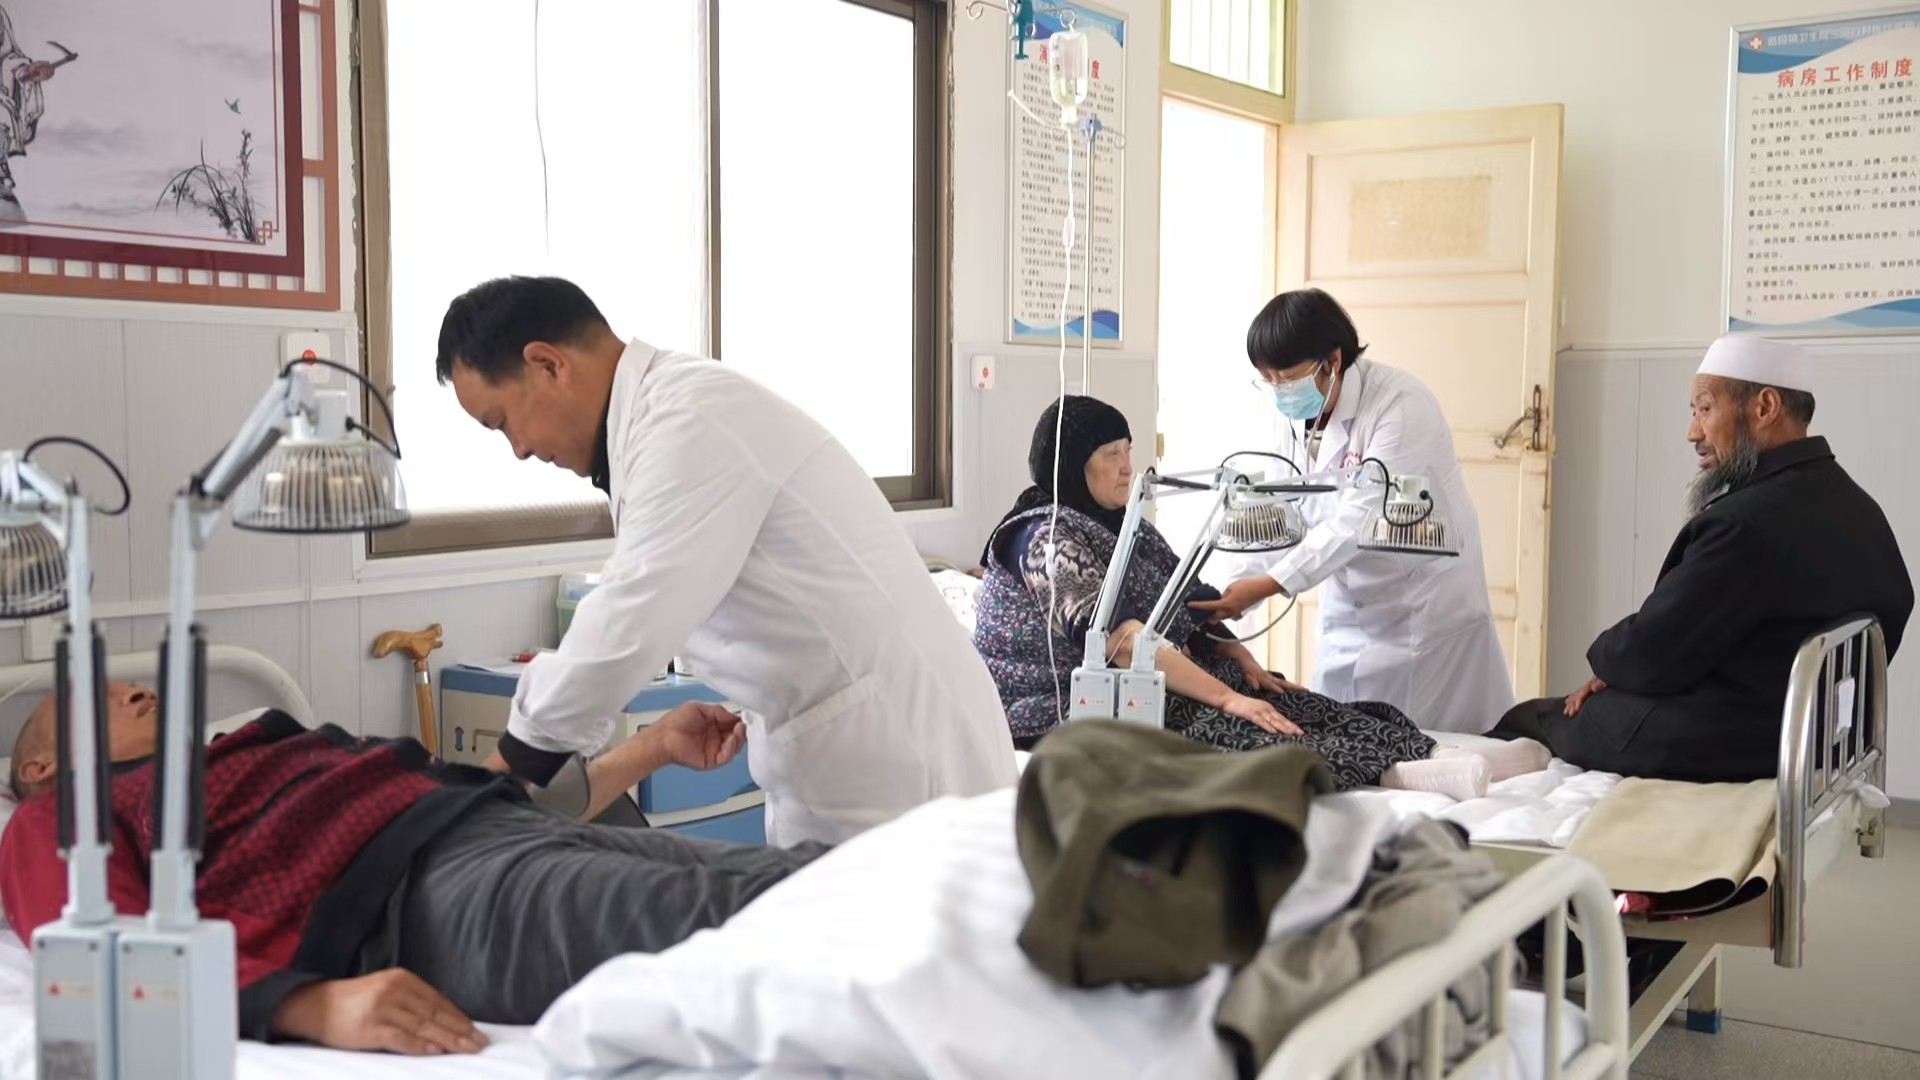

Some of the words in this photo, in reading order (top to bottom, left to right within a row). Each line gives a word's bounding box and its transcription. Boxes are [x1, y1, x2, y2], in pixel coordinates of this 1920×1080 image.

[1777, 57, 1912, 88] 病房工作制度
